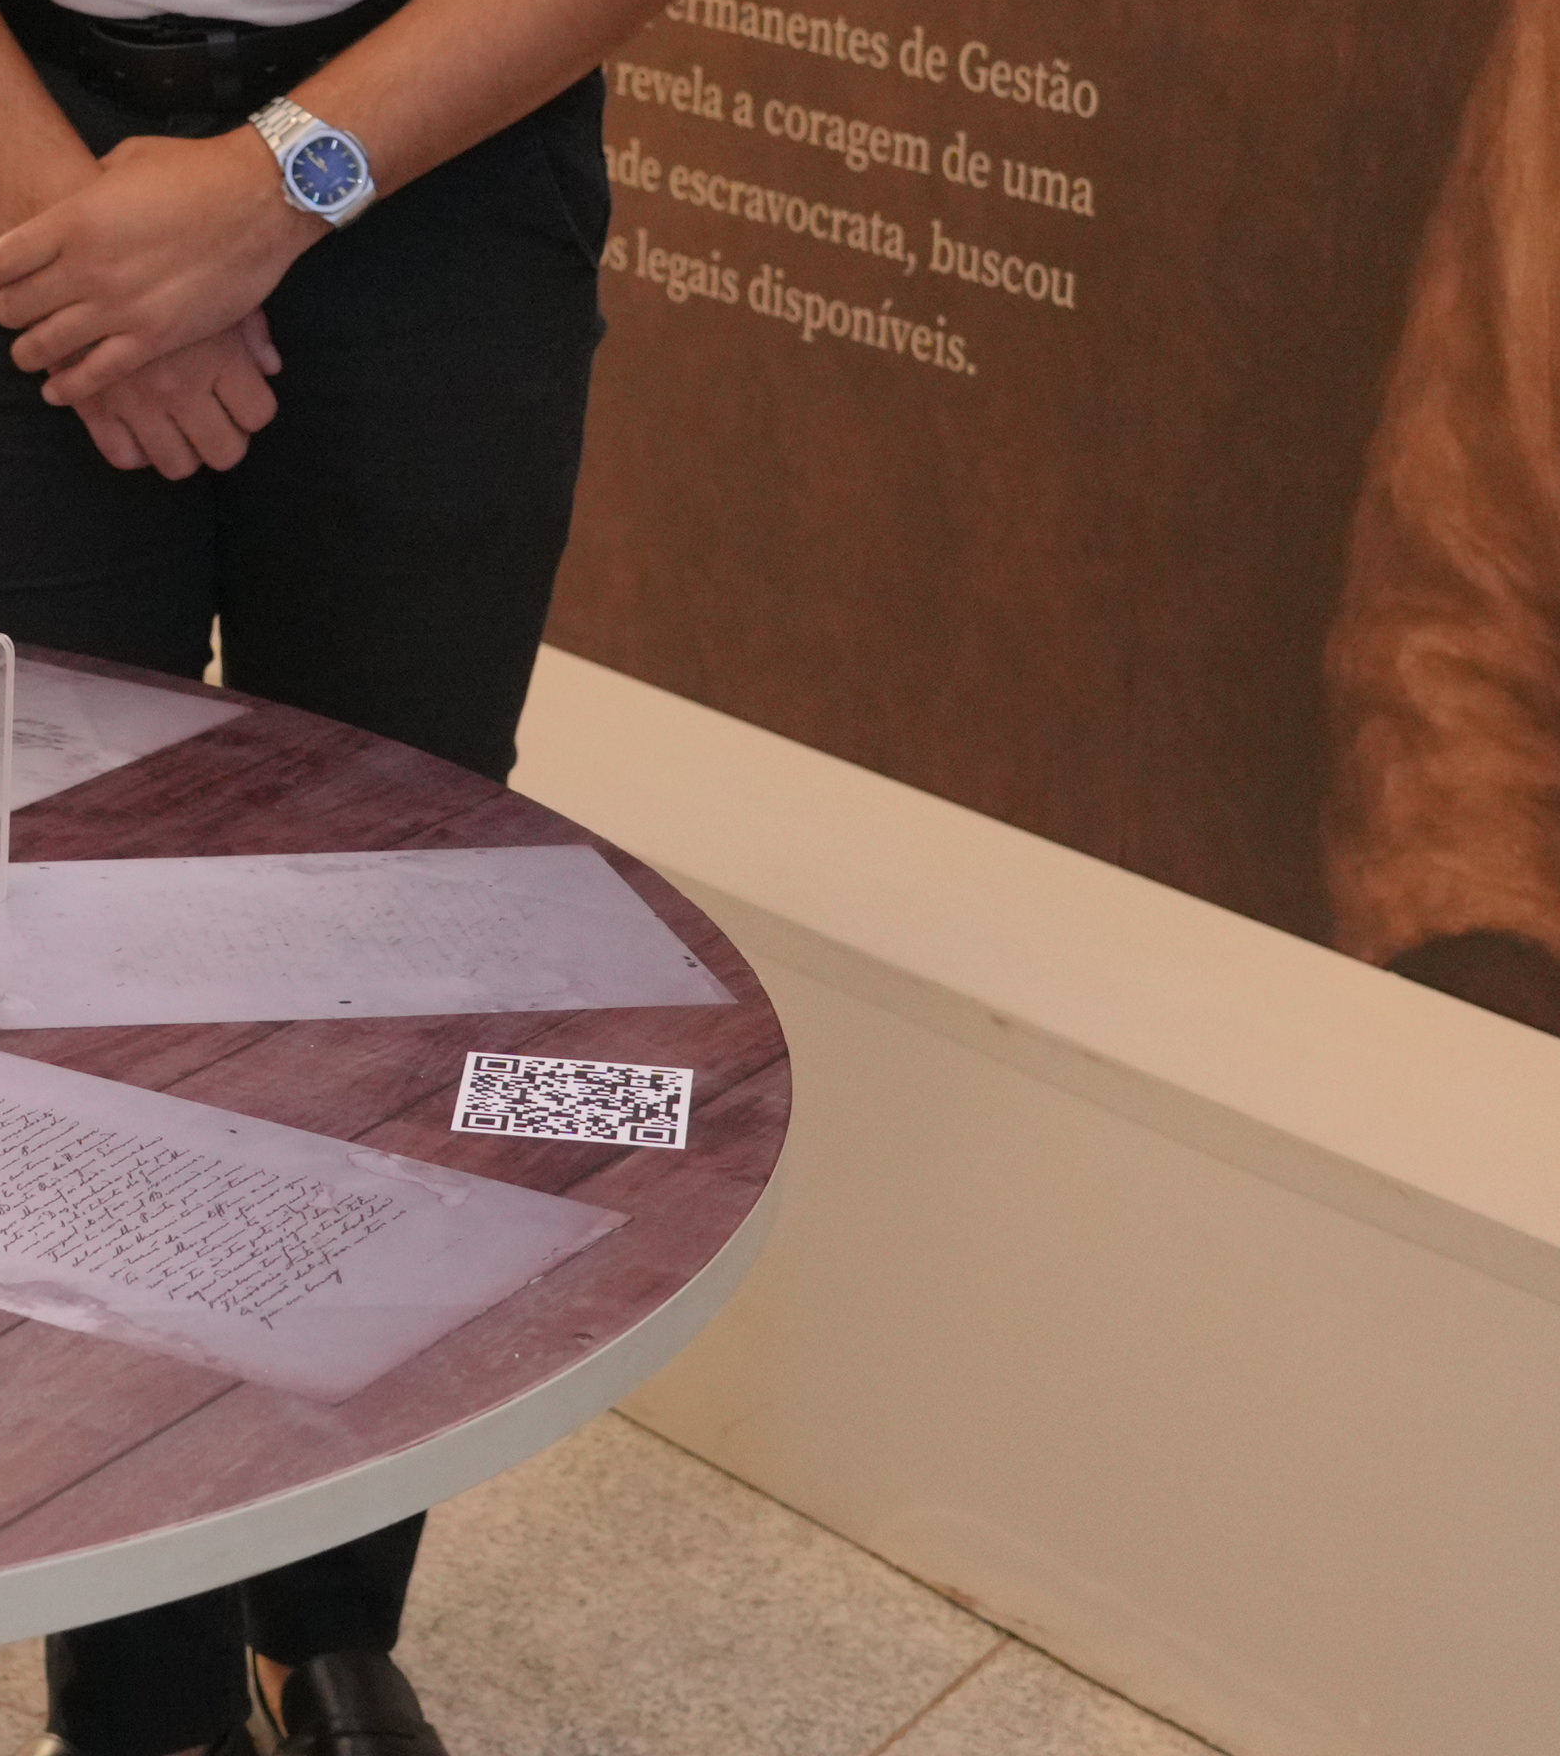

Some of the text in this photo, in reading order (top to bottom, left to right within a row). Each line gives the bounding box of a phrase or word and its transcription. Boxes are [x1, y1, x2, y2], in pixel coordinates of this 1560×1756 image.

[615, 61, 1097, 218] revela a coragem de uma
[899, 25, 949, 83] de
[957, 40, 1100, 120] Gestão
[599, 226, 979, 377] s legais disponíveis.
[668, 163, 919, 277] escravocrata,
[930, 220, 1077, 310] buscou
